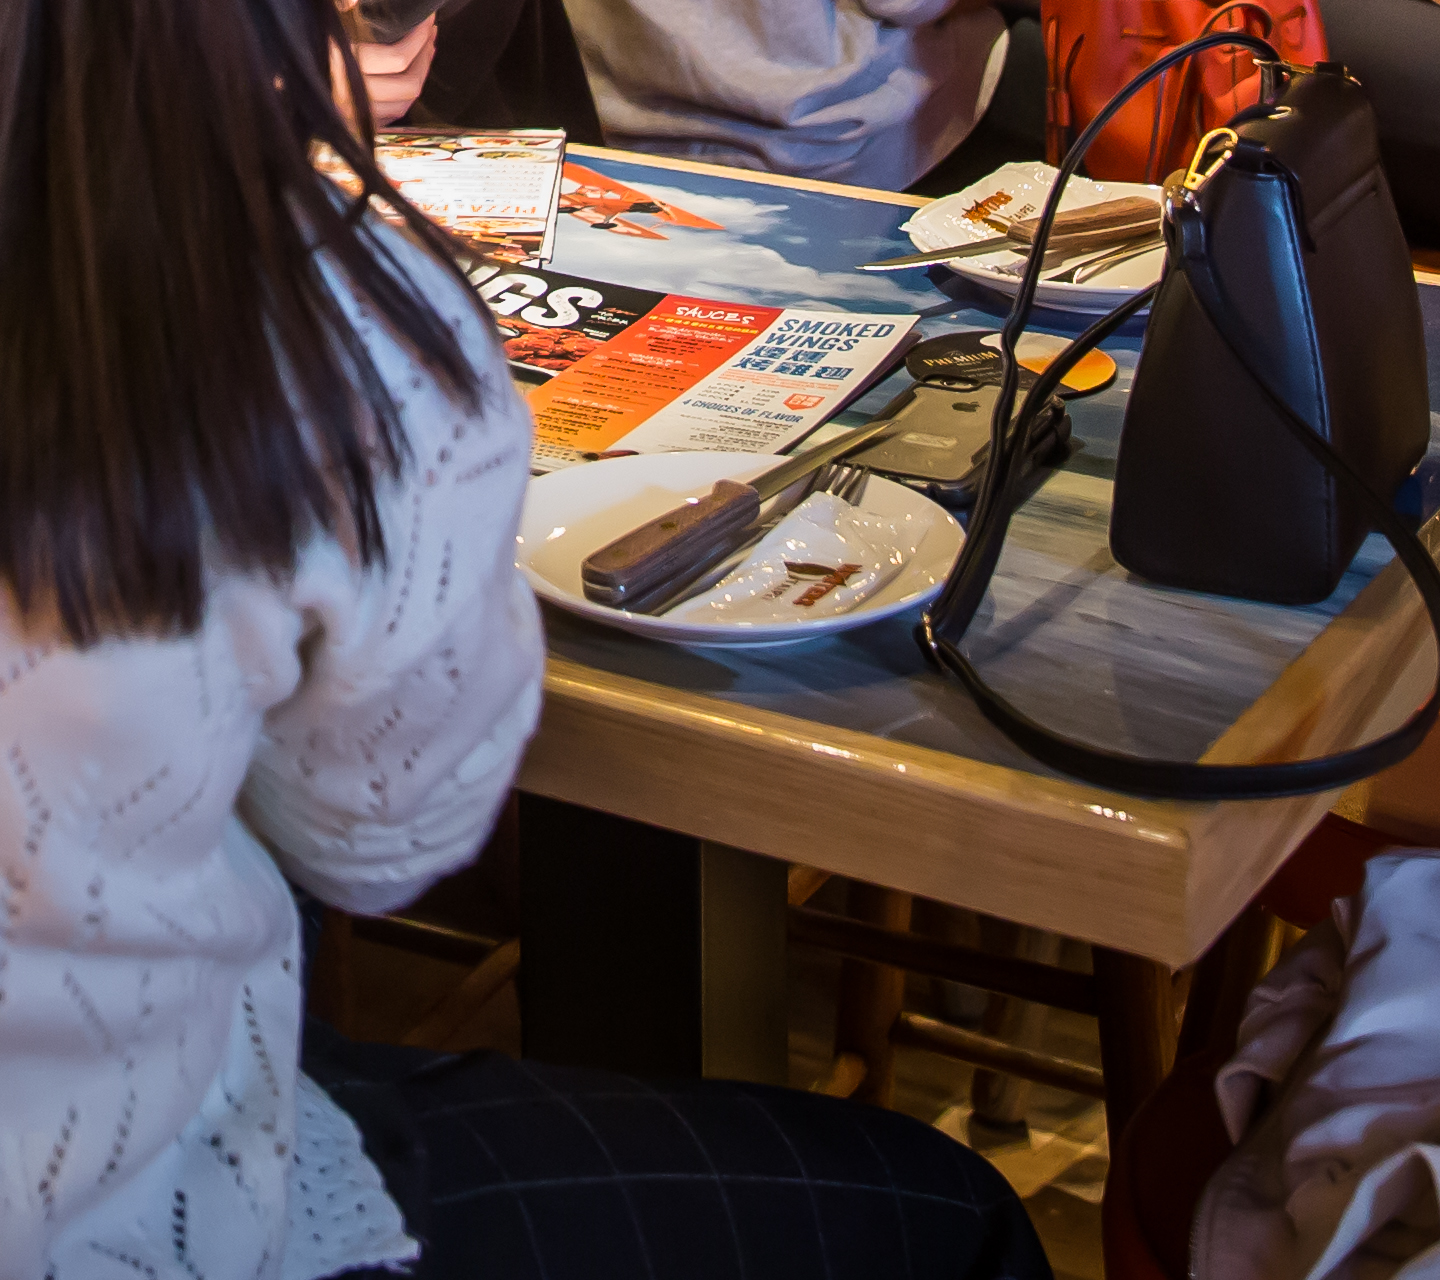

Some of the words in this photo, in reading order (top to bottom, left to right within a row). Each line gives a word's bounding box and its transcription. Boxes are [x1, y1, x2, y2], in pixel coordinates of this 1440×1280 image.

[676, 305, 755, 325] SAUCES
[777, 318, 896, 339] SMOKED
[763, 333, 860, 352] WINGS
[922, 351, 999, 367] PREMIUM
[691, 400, 742, 414] CHOICES
[740, 407, 760, 416] OF
[759, 410, 804, 423] FLAVOR
